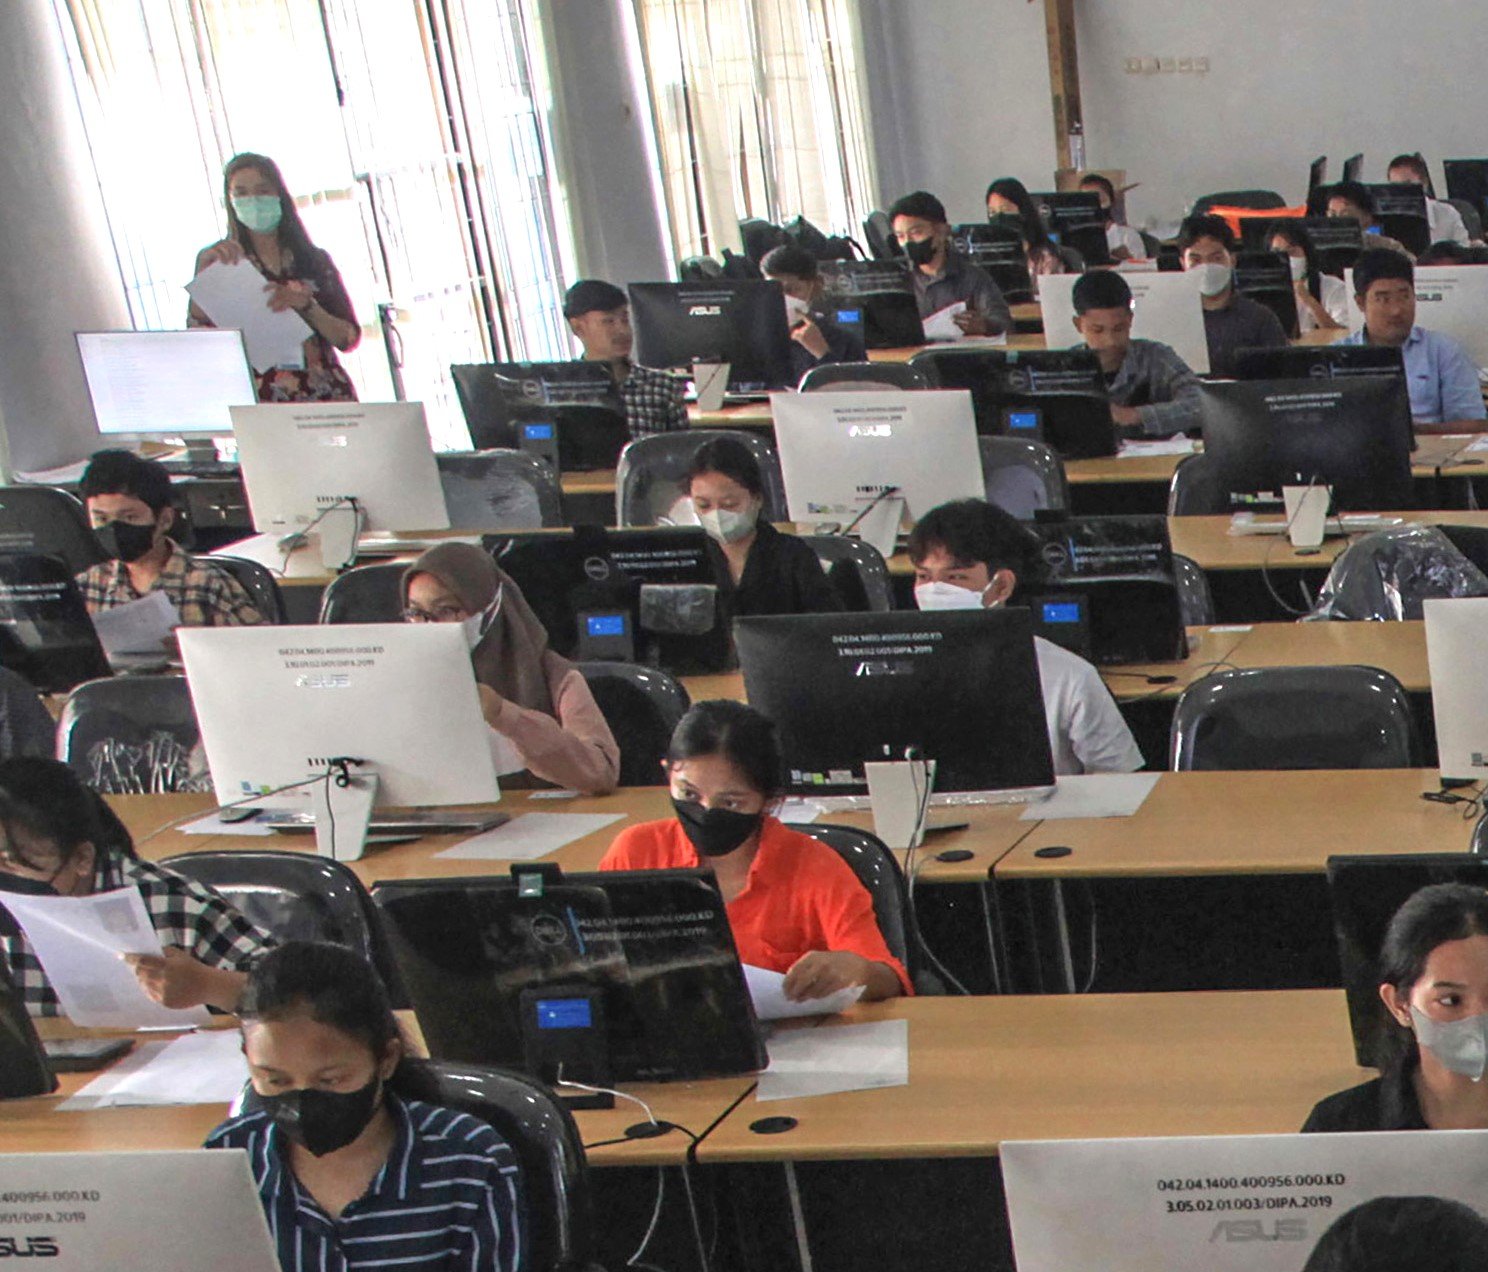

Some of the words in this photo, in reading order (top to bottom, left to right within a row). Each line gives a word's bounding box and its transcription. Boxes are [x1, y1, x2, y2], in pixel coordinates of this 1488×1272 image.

[690, 305, 721, 315] ASUS
[849, 424, 893, 438] ASUS
[1157, 1173, 1346, 1192] 042.04.1400.400956.000.KD
[0, 1190, 100, 1203] 400956.000.KD
[1166, 1196, 1333, 1213] 3.05.02.01.003/DIPA.2019
[1207, 1218, 1309, 1244] ASUS
